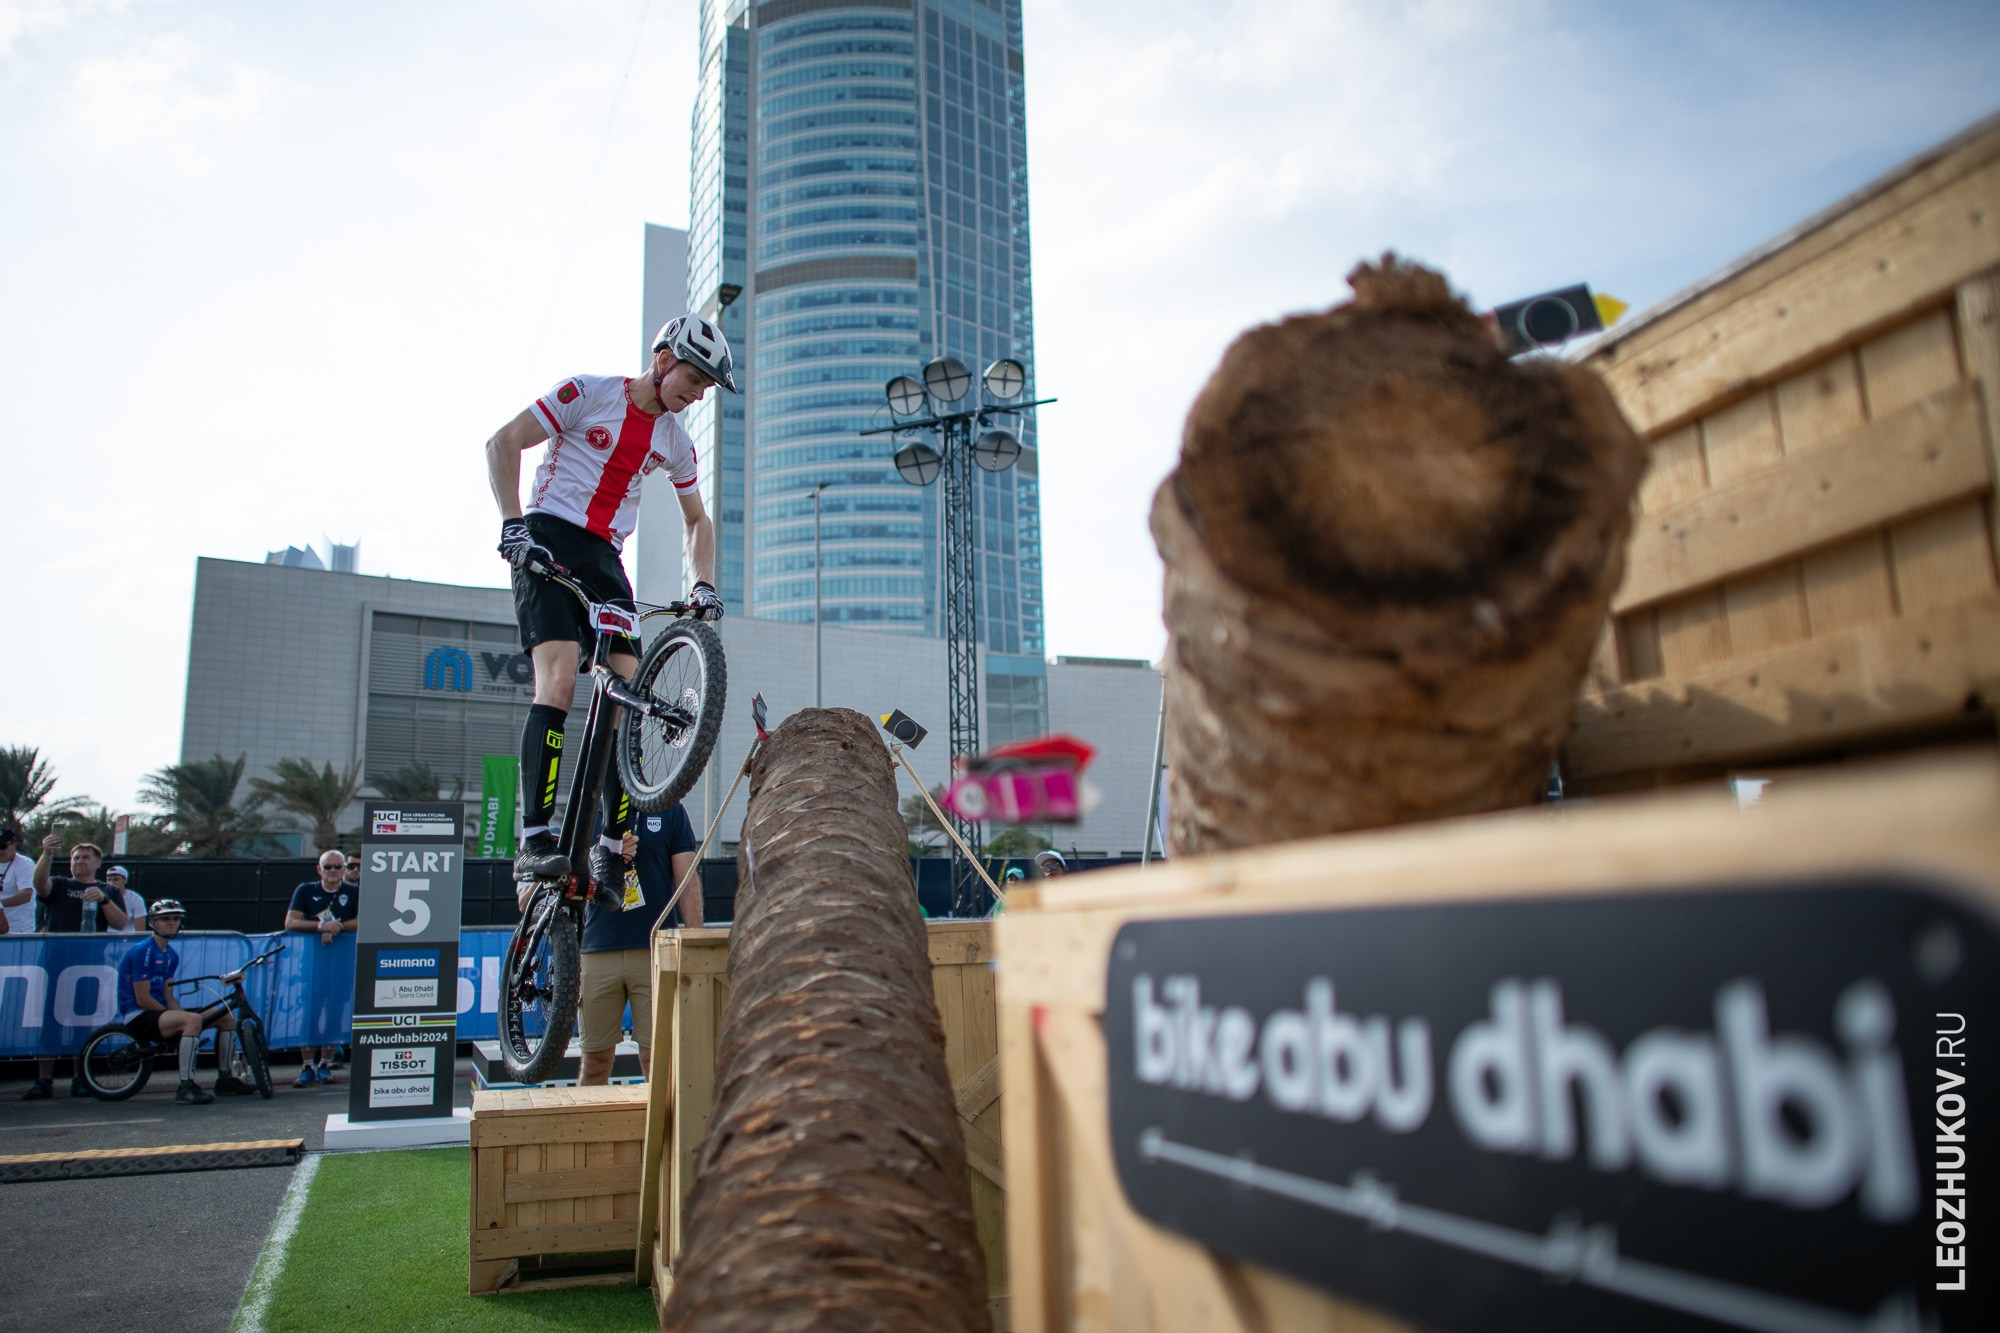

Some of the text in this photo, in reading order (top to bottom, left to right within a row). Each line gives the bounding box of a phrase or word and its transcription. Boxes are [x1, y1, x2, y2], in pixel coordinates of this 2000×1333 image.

[481, 652, 536, 684] VO
[378, 813, 399, 821] UCI
[484, 797, 499, 841] DHABI
[370, 851, 455, 873] START
[388, 878, 431, 937] 5
[379, 958, 436, 968] SHIMANO
[392, 1015, 417, 1026] UCI
[359, 1032, 449, 1045] #Abudhabi2024
[380, 1060, 427, 1070] TISSOT
[373, 1085, 431, 1095] bike abu dhabi
[1133, 972, 1919, 1222] bike abu dhabi
